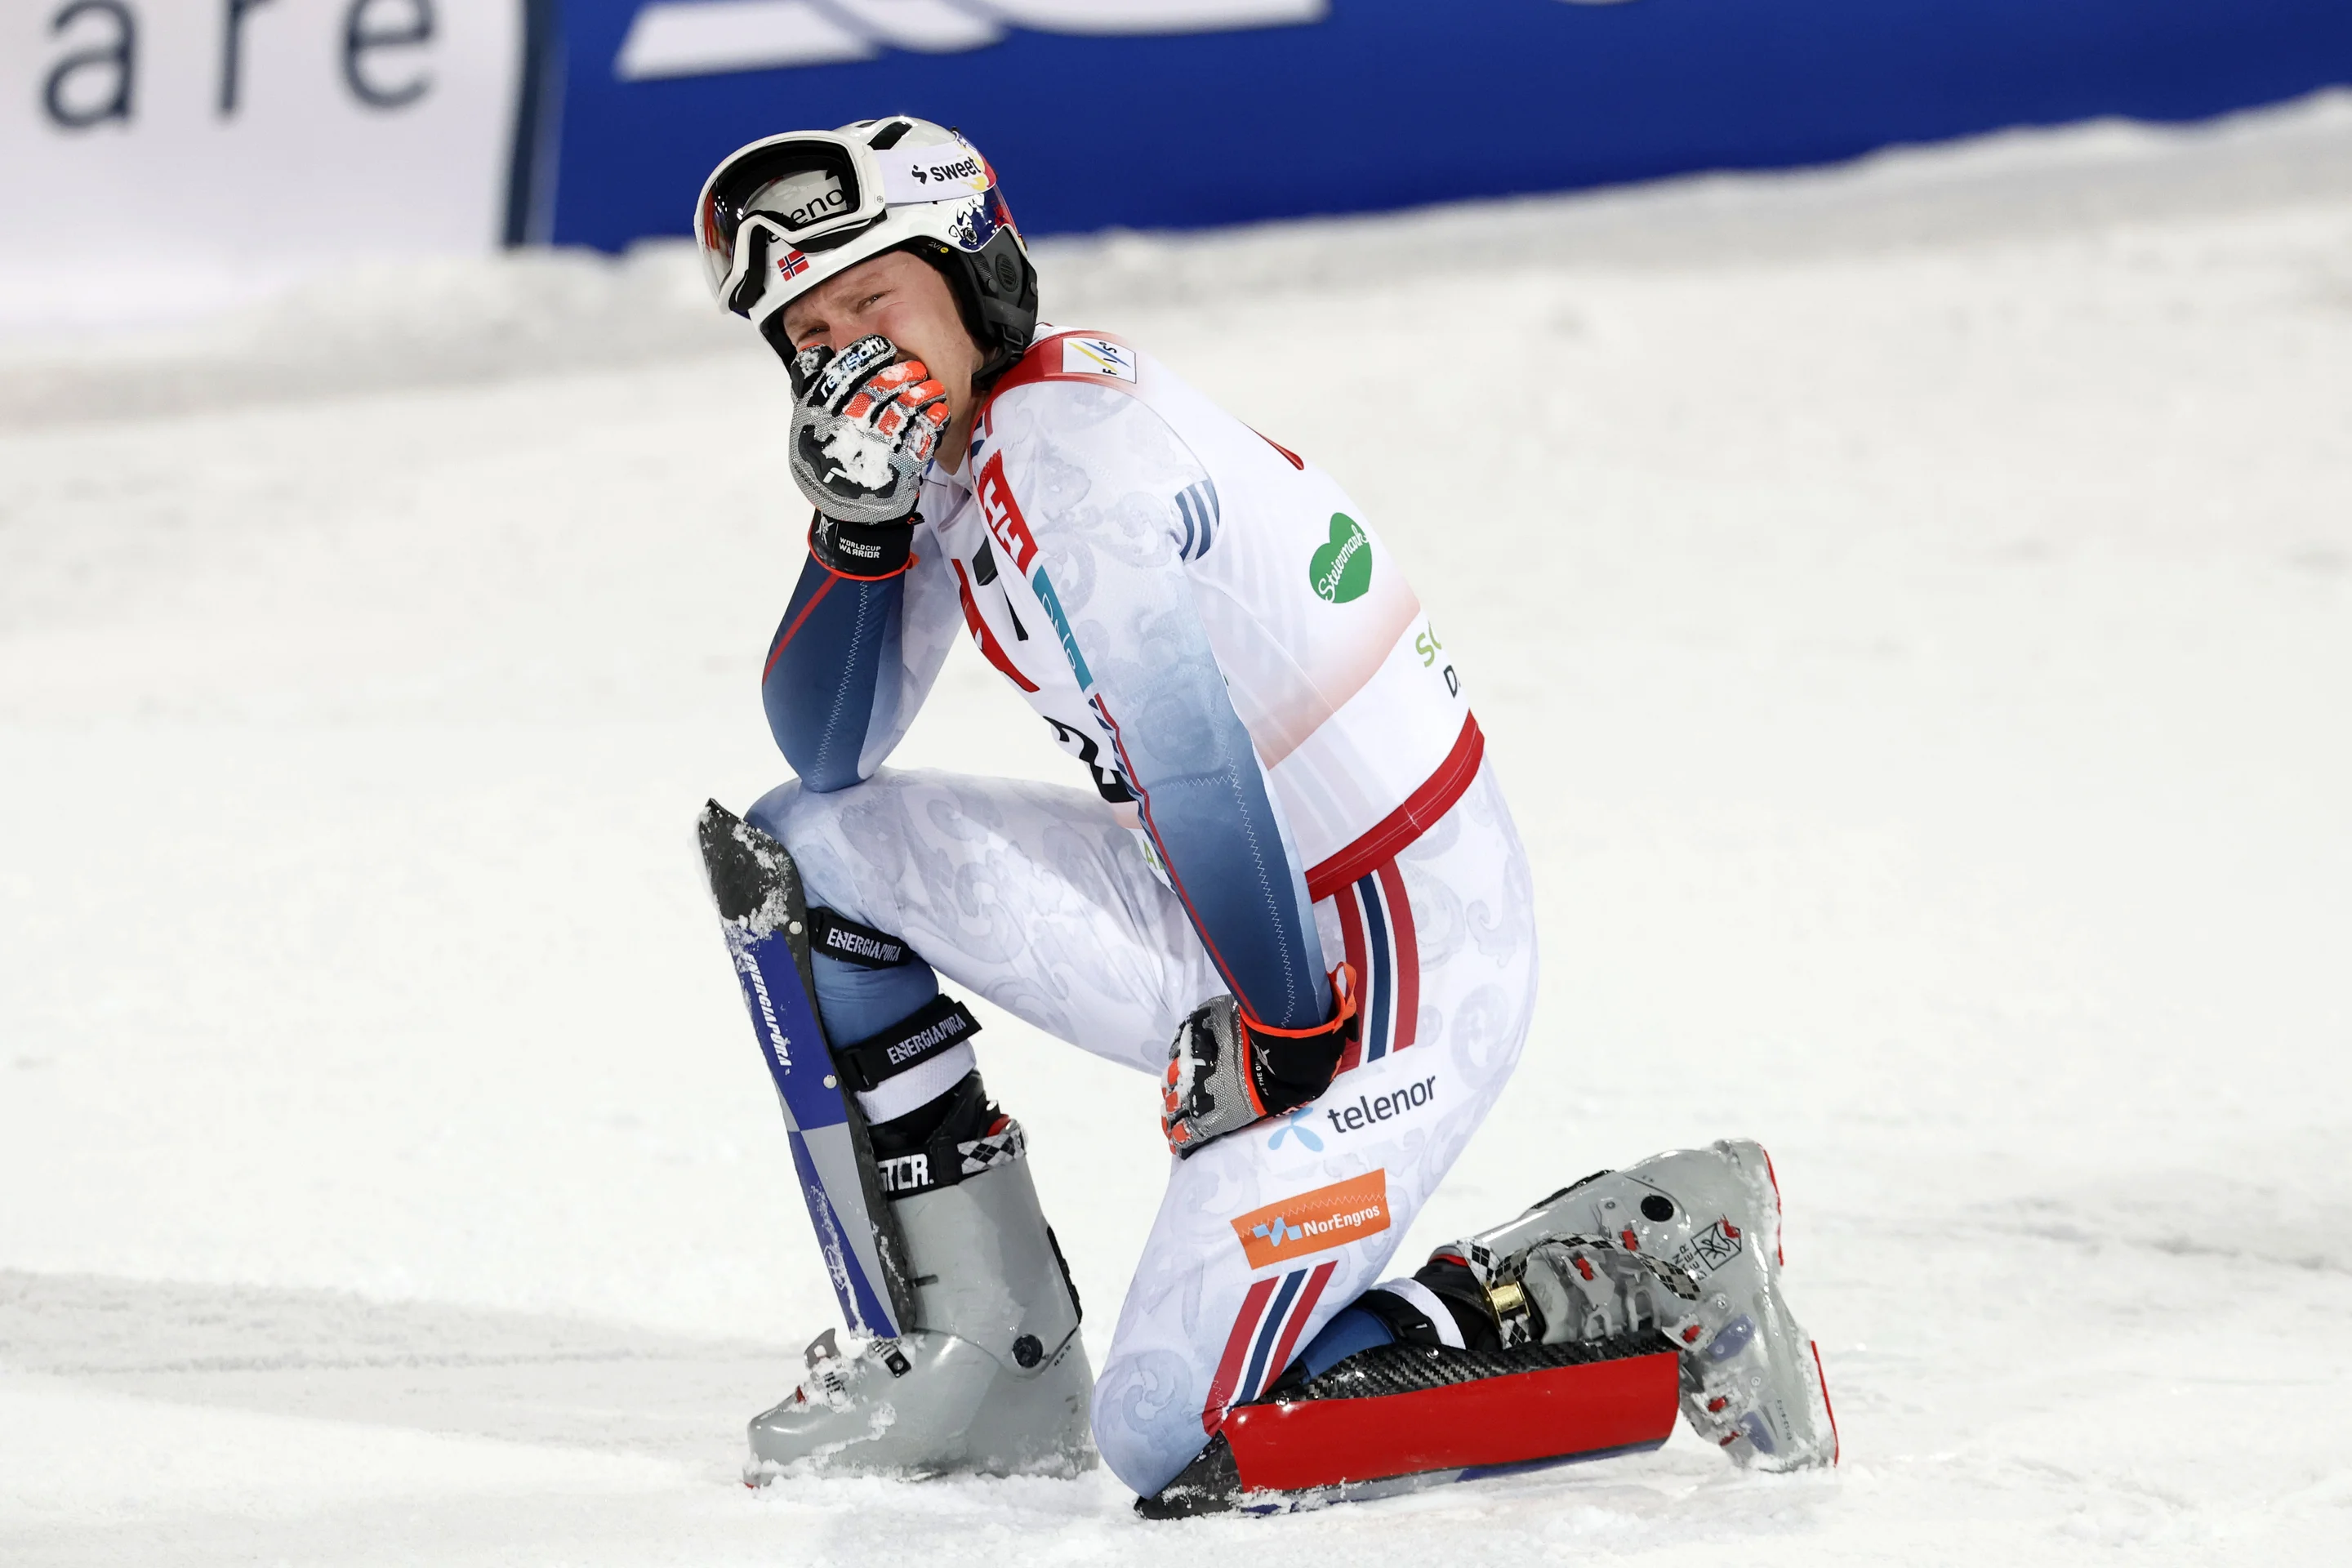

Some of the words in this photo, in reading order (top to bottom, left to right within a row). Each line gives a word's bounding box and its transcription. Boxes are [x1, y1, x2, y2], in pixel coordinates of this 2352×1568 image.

[929, 156, 982, 182] sweet
[1102, 345, 1118, 376] FIS
[839, 542, 880, 559] WARRIOR
[840, 537, 881, 552] WORLDCUP
[1318, 523, 1370, 604] Steiermark
[1443, 664, 1461, 699] D
[826, 927, 902, 962] ENERGIAPURA
[744, 951, 792, 1067] ENERGIAPURA
[886, 1013, 967, 1066] ENERGIAPURA
[1327, 1076, 1436, 1134] telenor
[1303, 1205, 1380, 1236] NorEngros
